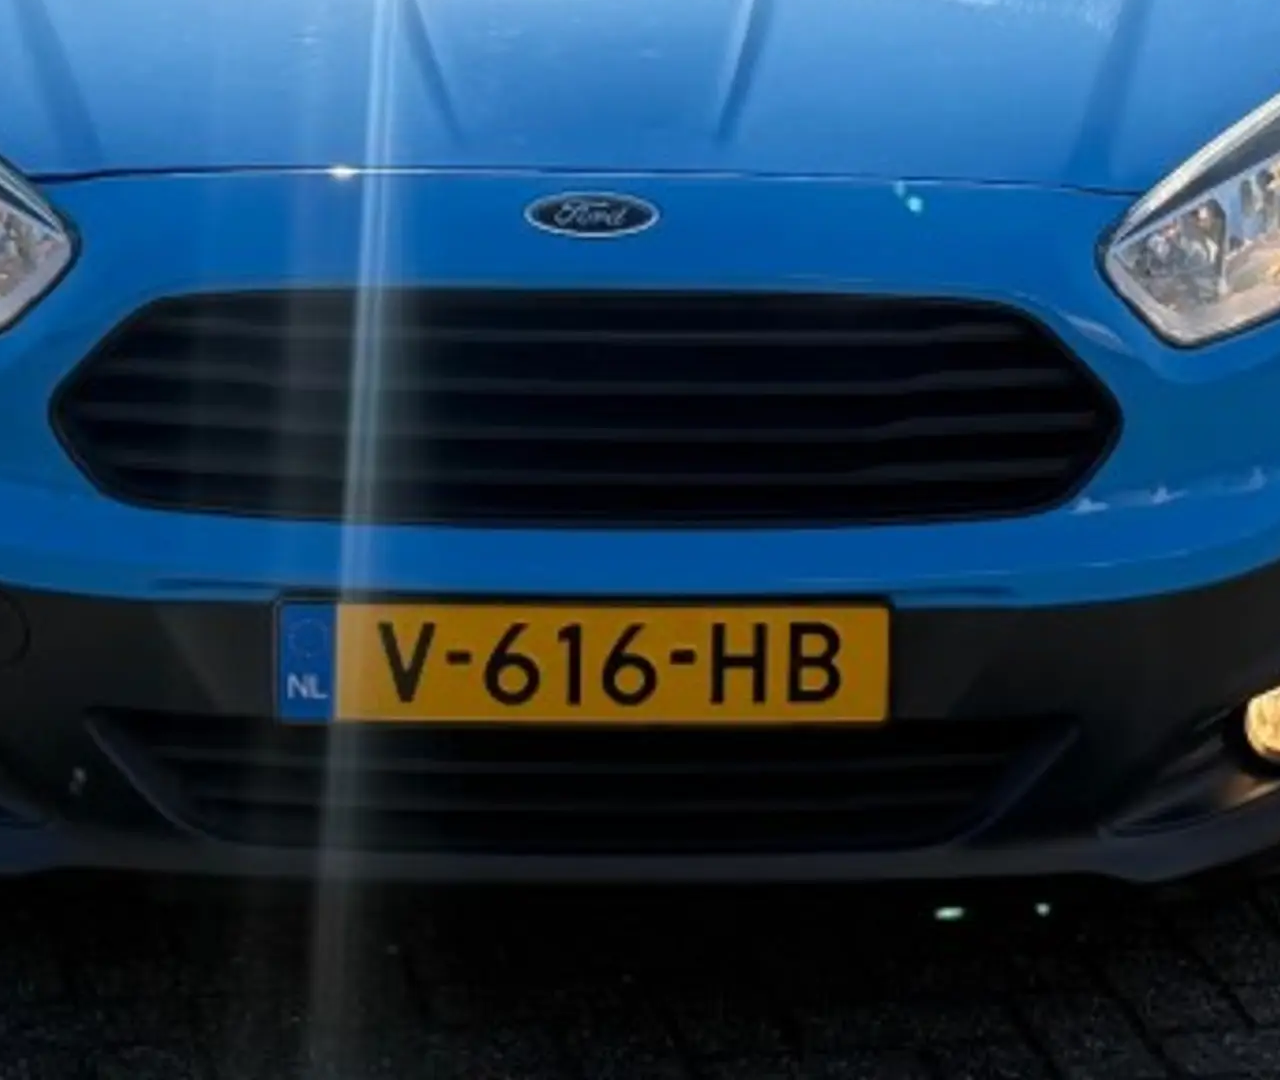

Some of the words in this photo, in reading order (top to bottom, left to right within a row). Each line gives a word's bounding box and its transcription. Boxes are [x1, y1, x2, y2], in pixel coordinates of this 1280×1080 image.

[553, 198, 628, 227] Ford
[377, 622, 842, 707] V-616-HB
[285, 673, 329, 700] NL
